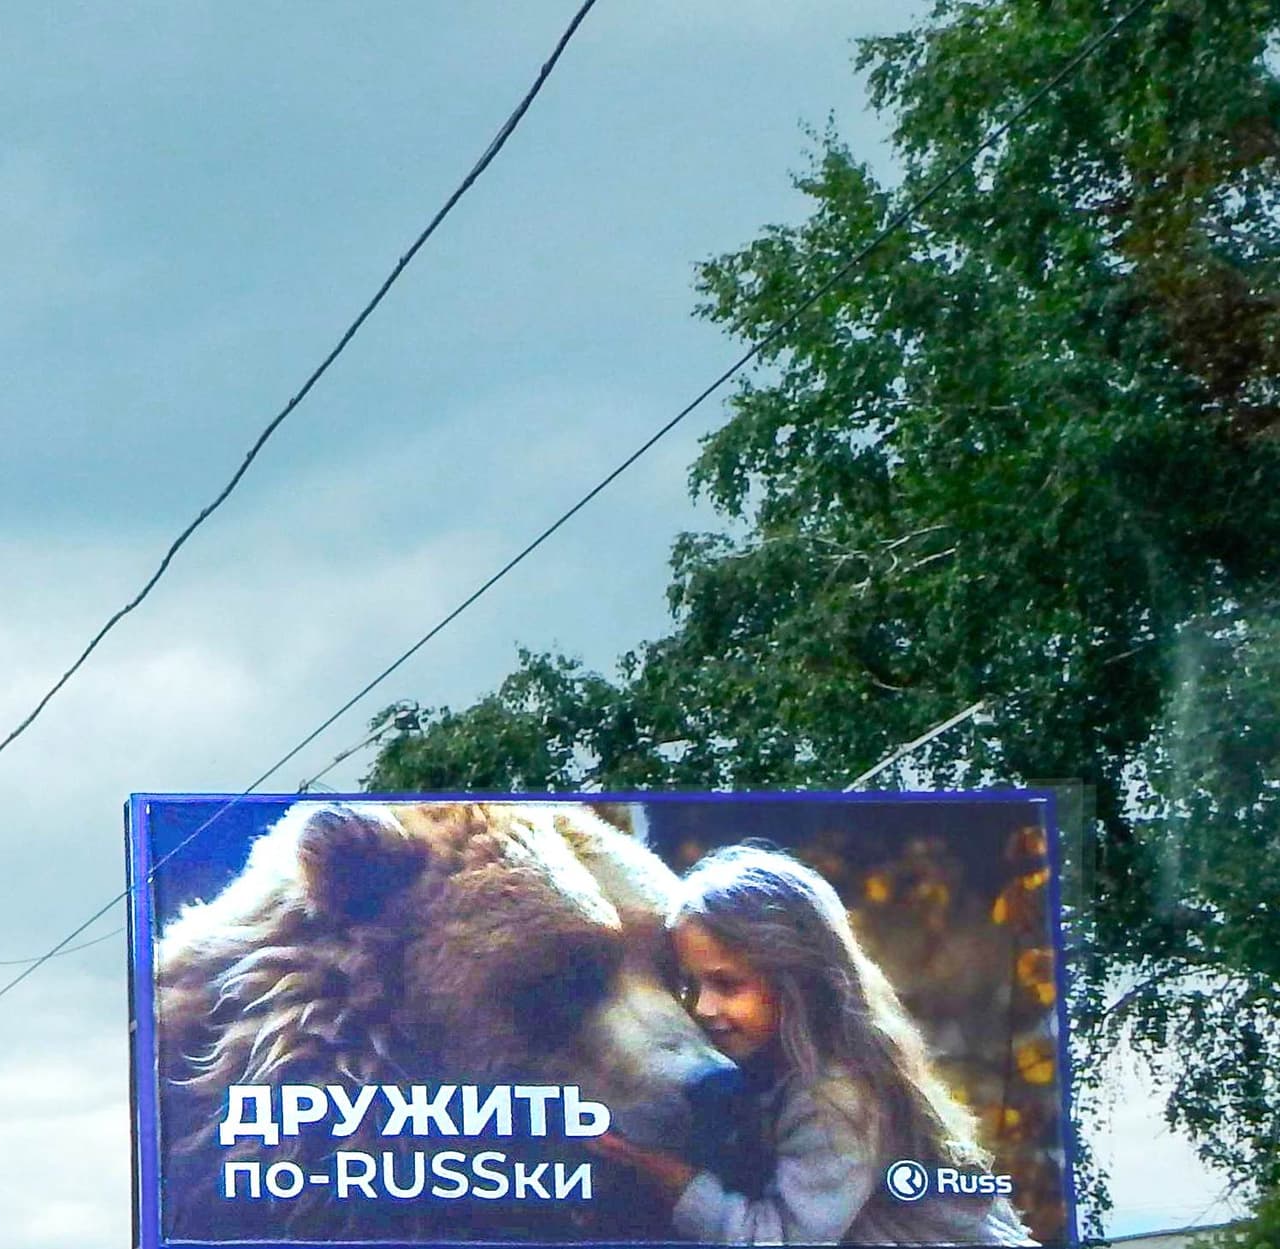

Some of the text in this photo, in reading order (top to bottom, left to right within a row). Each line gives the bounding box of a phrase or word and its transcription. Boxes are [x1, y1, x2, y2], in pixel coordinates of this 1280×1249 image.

[219, 1085, 611, 1146] ДРУЖИТЬ
[225, 1151, 592, 1200] по-RUSSки
[937, 1168, 1013, 1194] Russ
